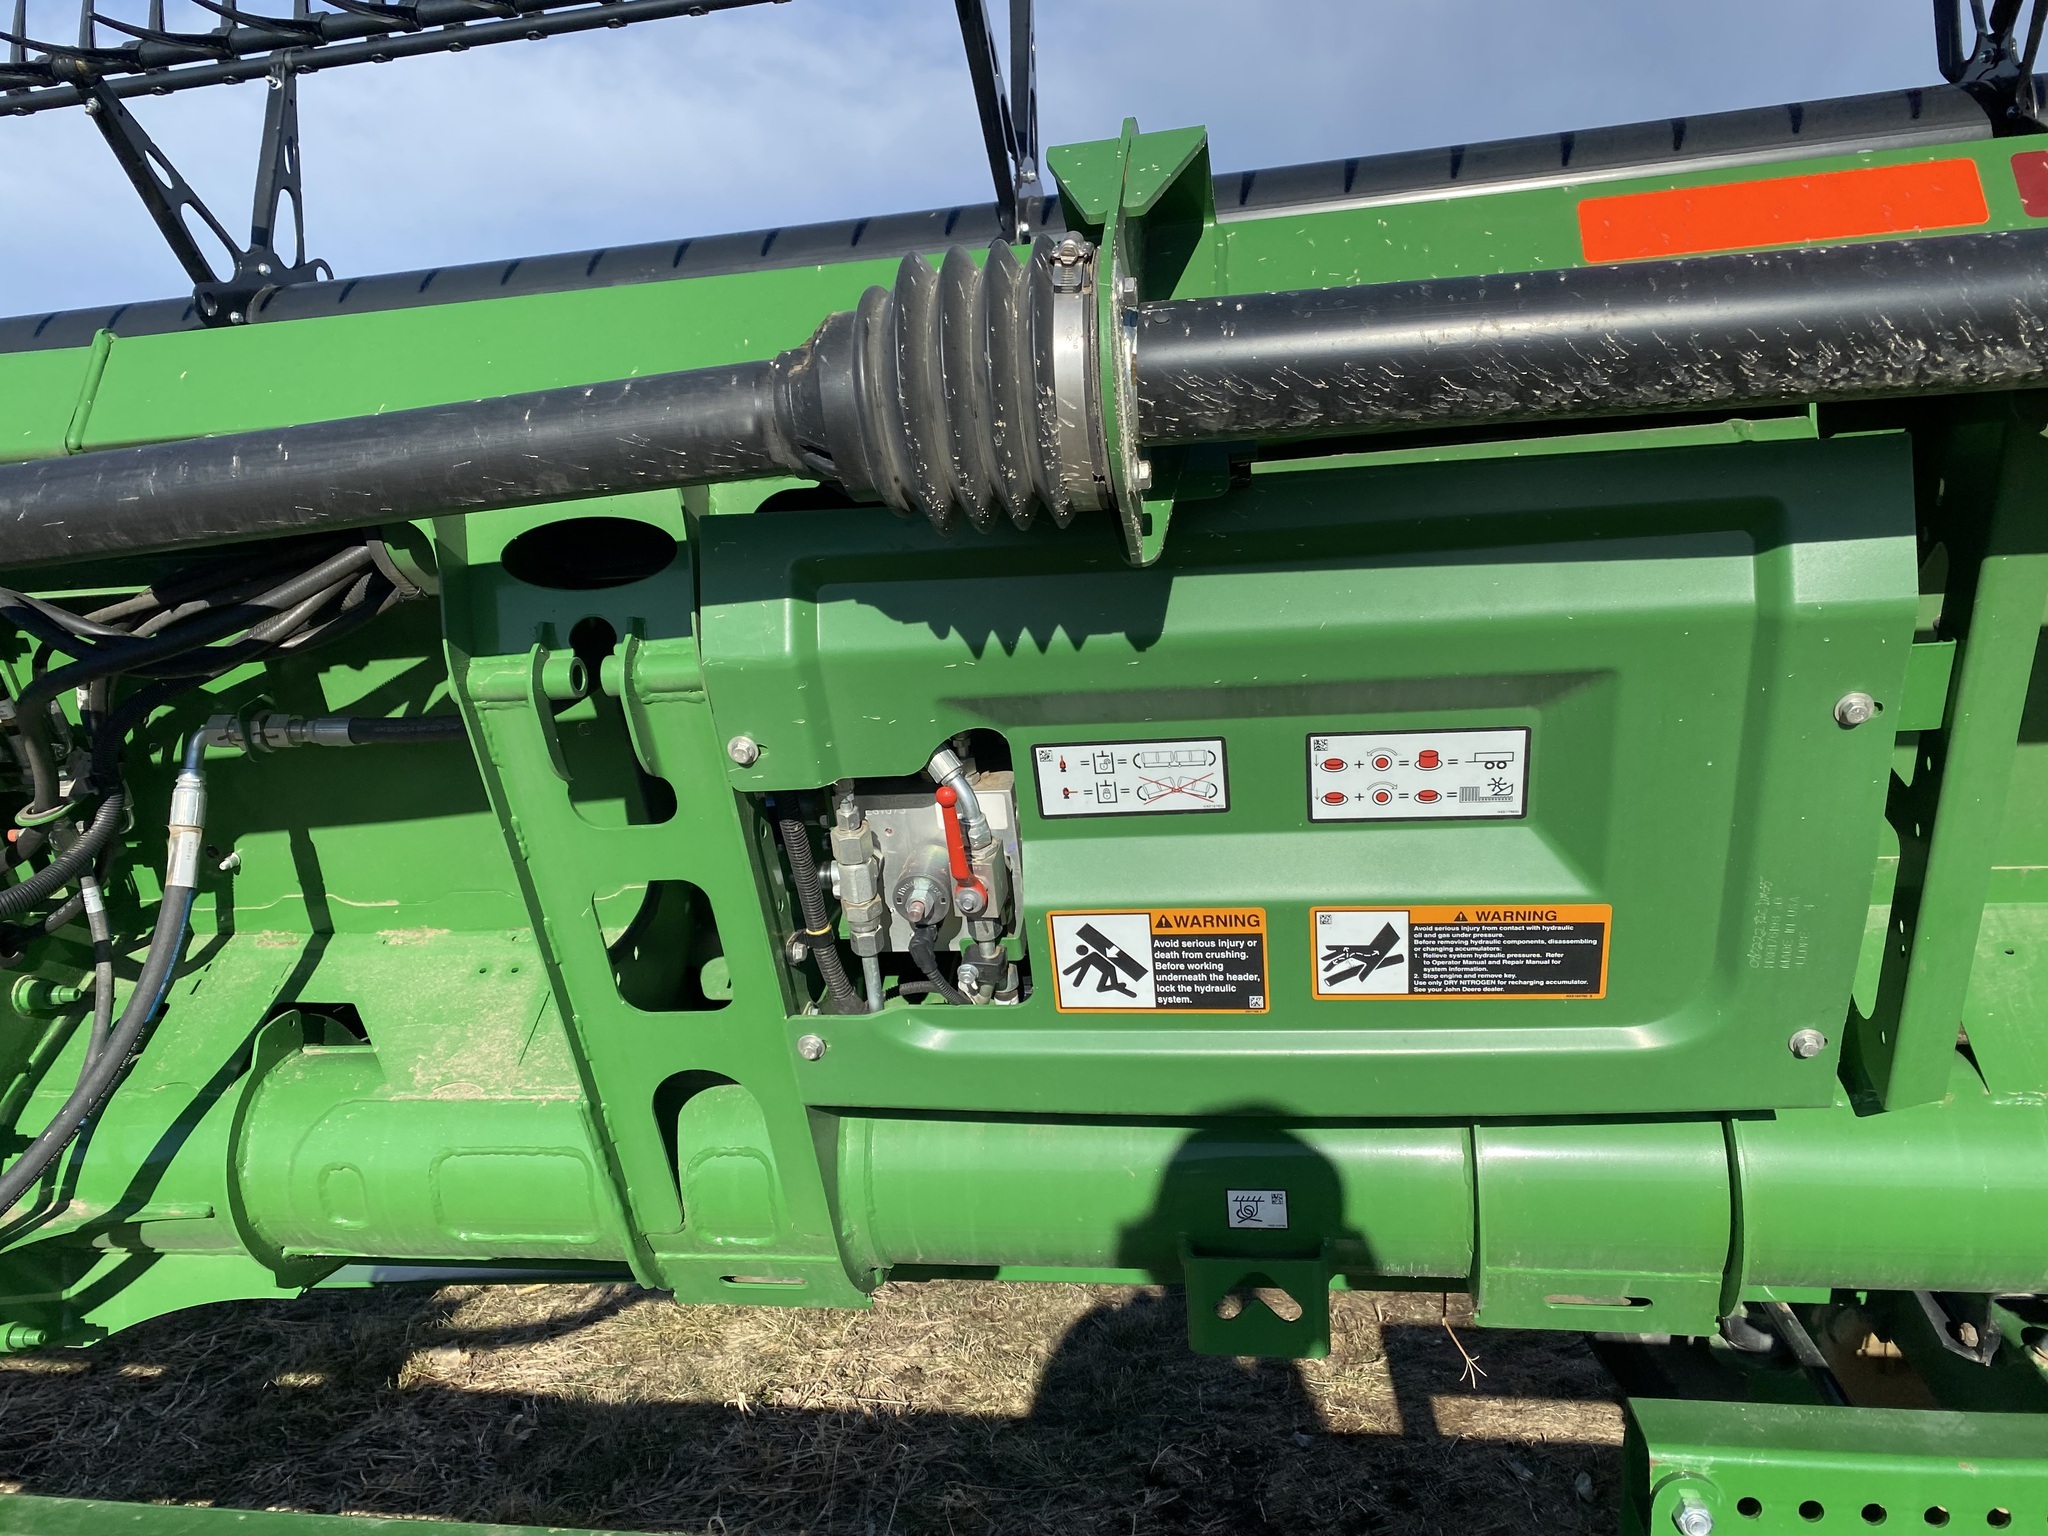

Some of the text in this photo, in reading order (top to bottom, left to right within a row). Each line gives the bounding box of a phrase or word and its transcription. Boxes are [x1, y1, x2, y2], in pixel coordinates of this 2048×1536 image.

[1174, 914, 1260, 927] WARNING
[1476, 911, 1557, 921] WARNING
[1218, 939, 1244, 948] injury
[1206, 951, 1248, 960] crushing.
[1187, 962, 1223, 972] working
[1227, 973, 1260, 982] header,
[1195, 984, 1236, 994] hydraulic
[1158, 996, 1192, 1005] system.
